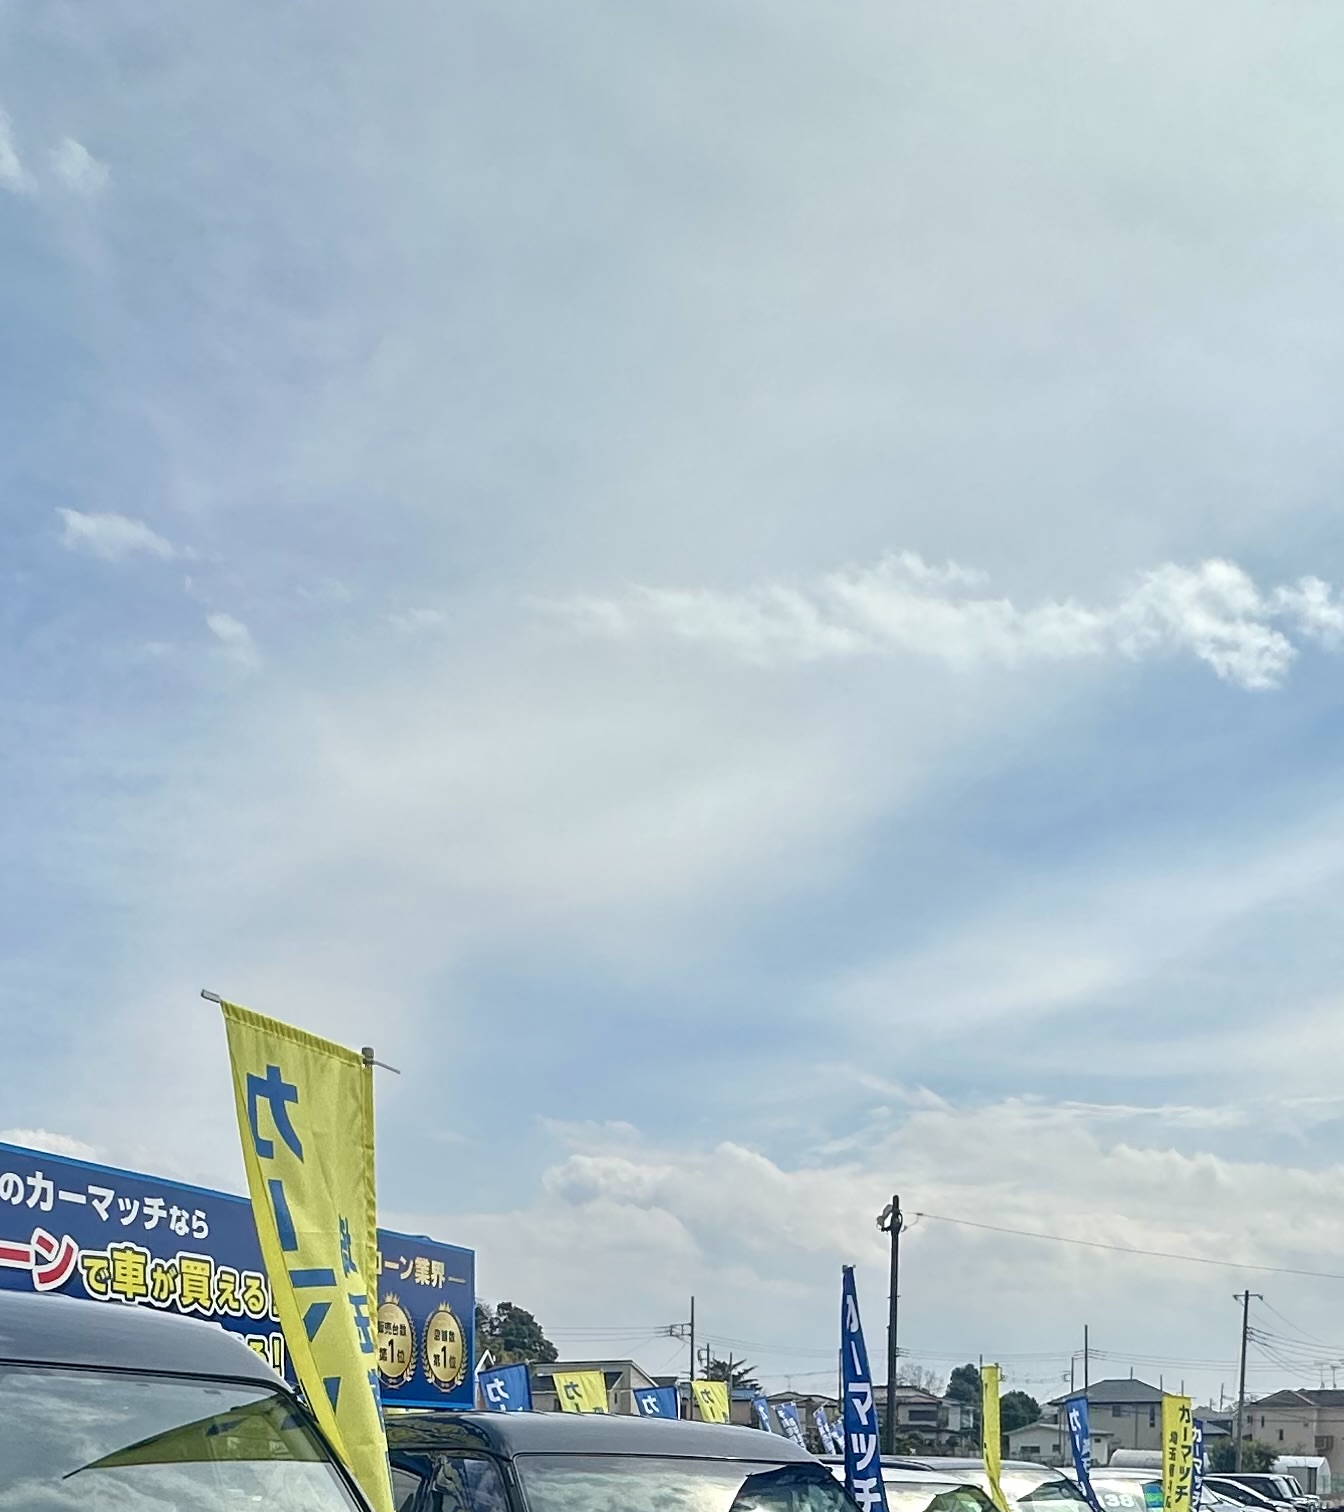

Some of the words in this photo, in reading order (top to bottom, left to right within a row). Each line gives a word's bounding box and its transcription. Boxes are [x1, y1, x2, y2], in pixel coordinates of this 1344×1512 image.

[379, 1339, 405, 1363] 第1位
[433, 1345, 456, 1369] 第1位
[1175, 1404, 1192, 1503] カーマッチ
